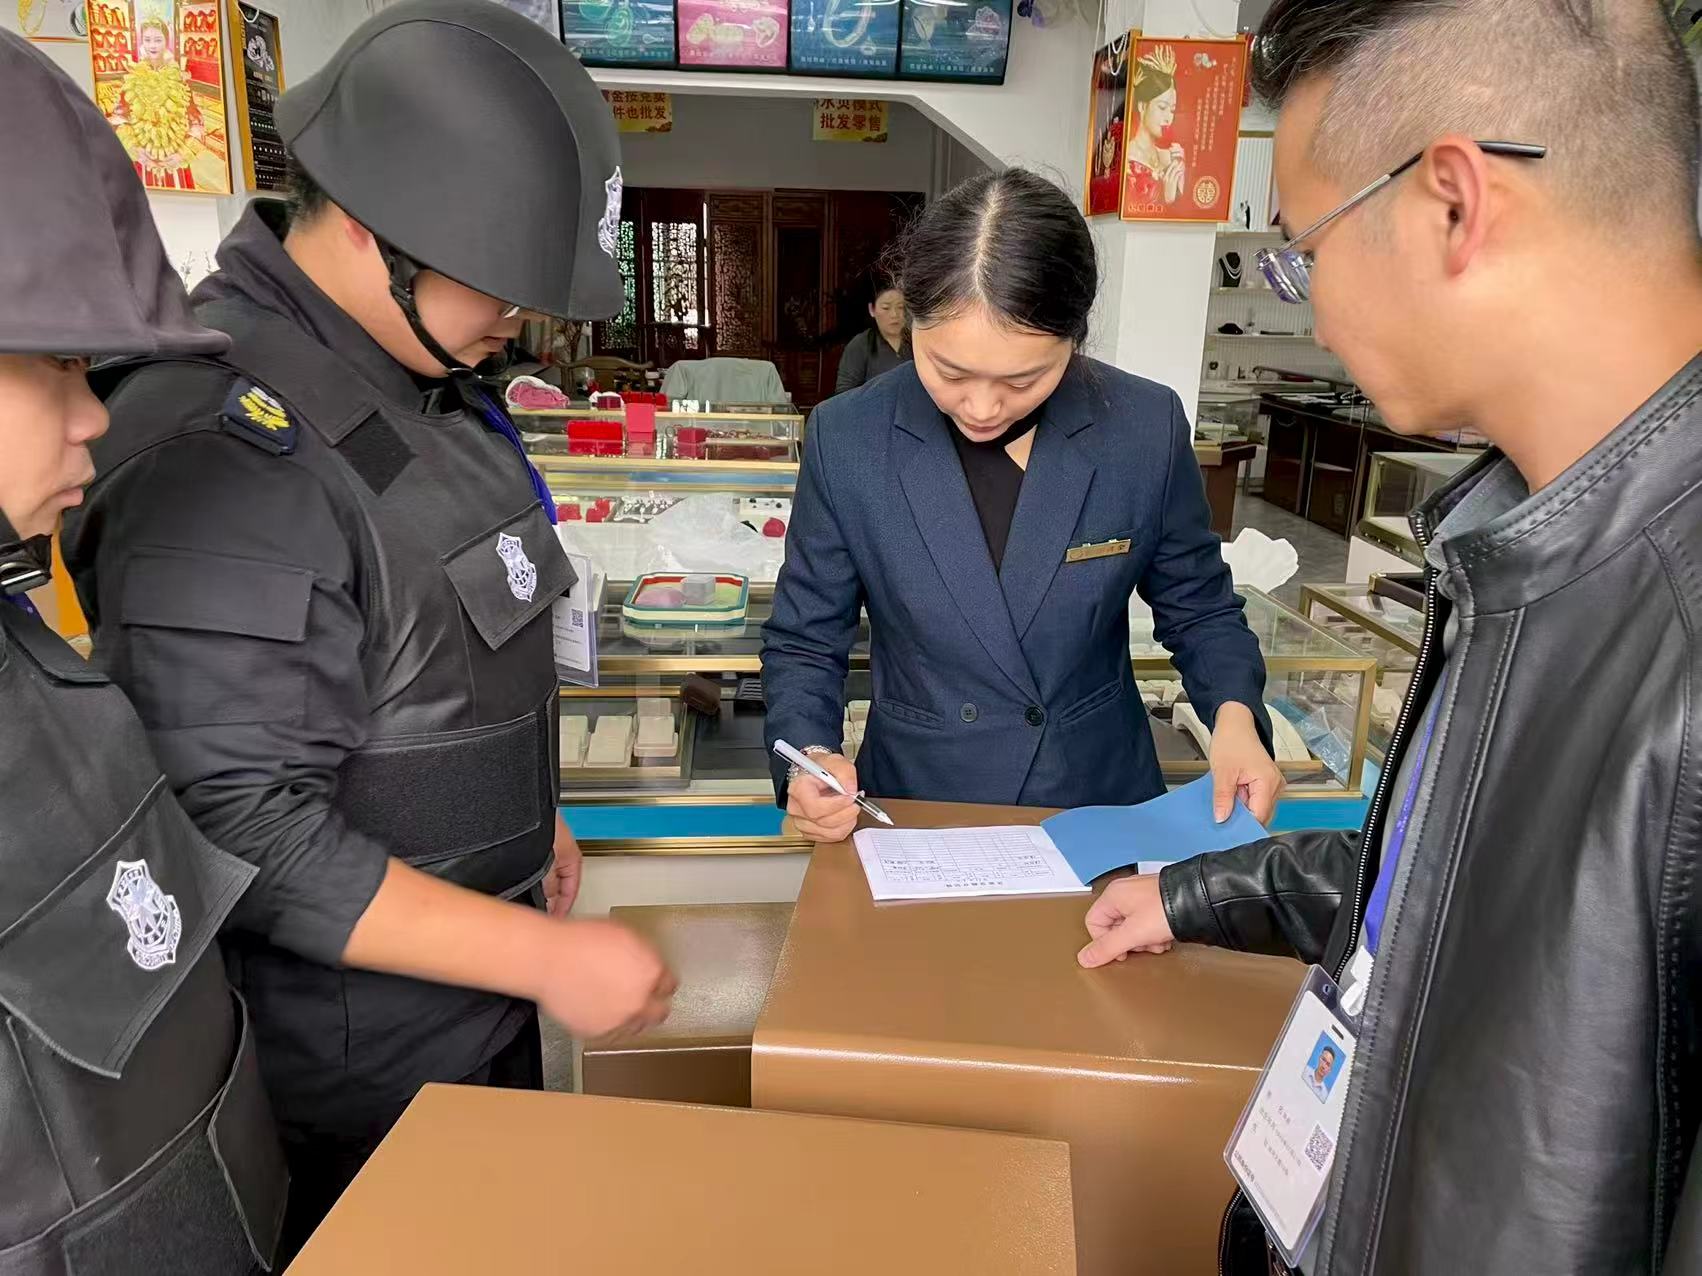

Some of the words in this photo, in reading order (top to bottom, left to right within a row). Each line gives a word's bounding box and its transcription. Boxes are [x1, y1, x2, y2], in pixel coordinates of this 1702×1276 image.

[613, 105, 667, 119] 件也批发
[820, 112, 881, 132] 批发零售
